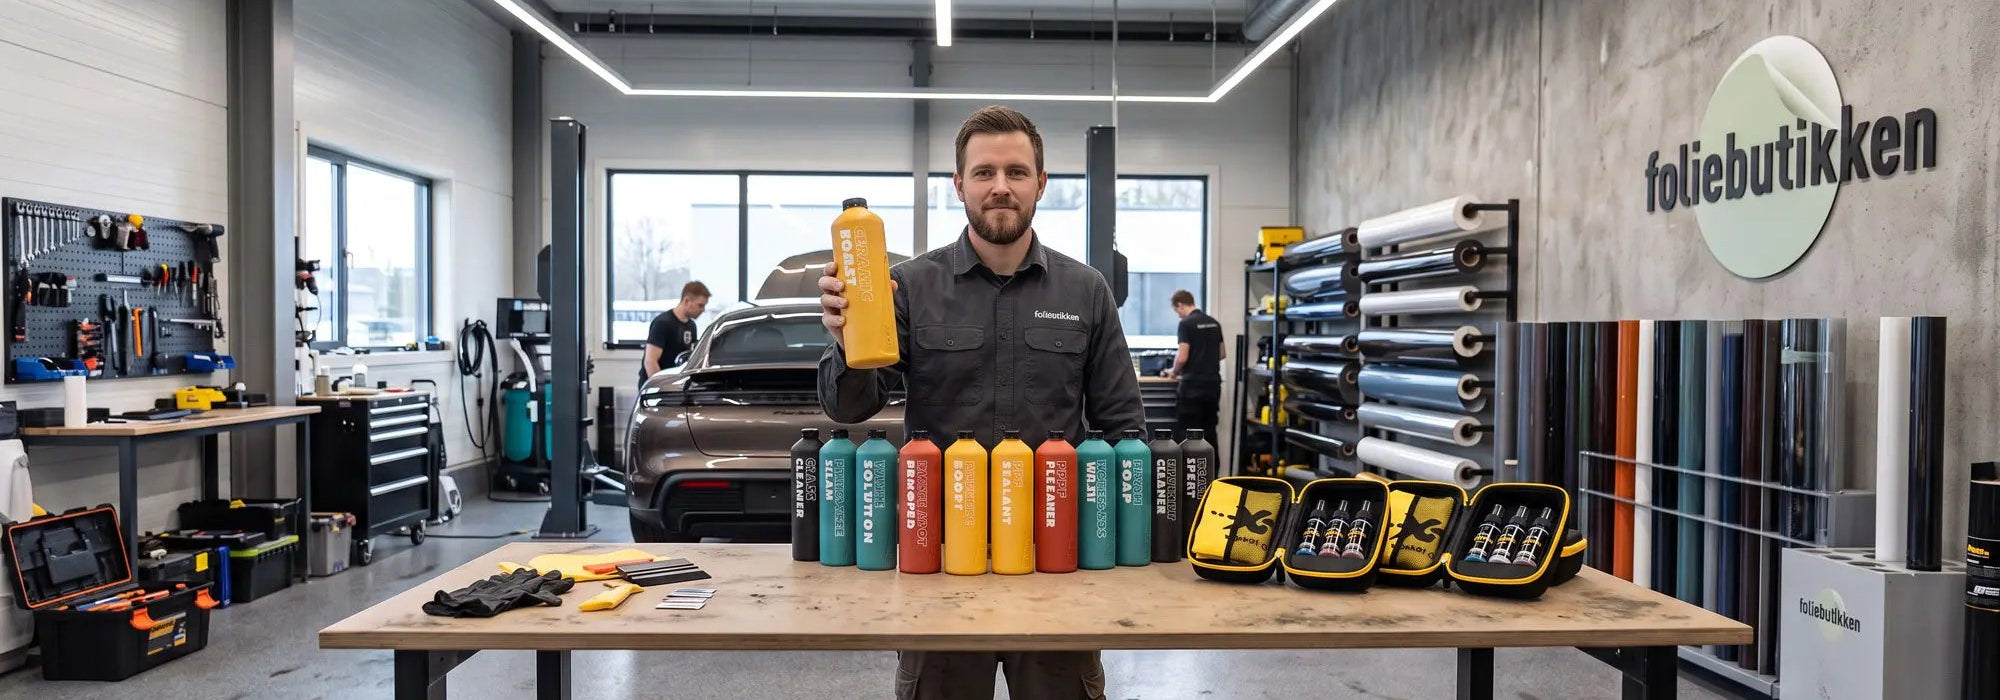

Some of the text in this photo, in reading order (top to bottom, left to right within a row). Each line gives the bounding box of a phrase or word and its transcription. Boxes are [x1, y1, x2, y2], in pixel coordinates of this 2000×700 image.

[1645, 104, 1937, 214] foliebutikken
[795, 458, 804, 518] CLEANER
[1002, 460, 1012, 526] SEALANT
[1122, 459, 1132, 504] SOAP
[1156, 458, 1167, 515] CLEANER
[1799, 597, 1861, 633] foliebutikken
